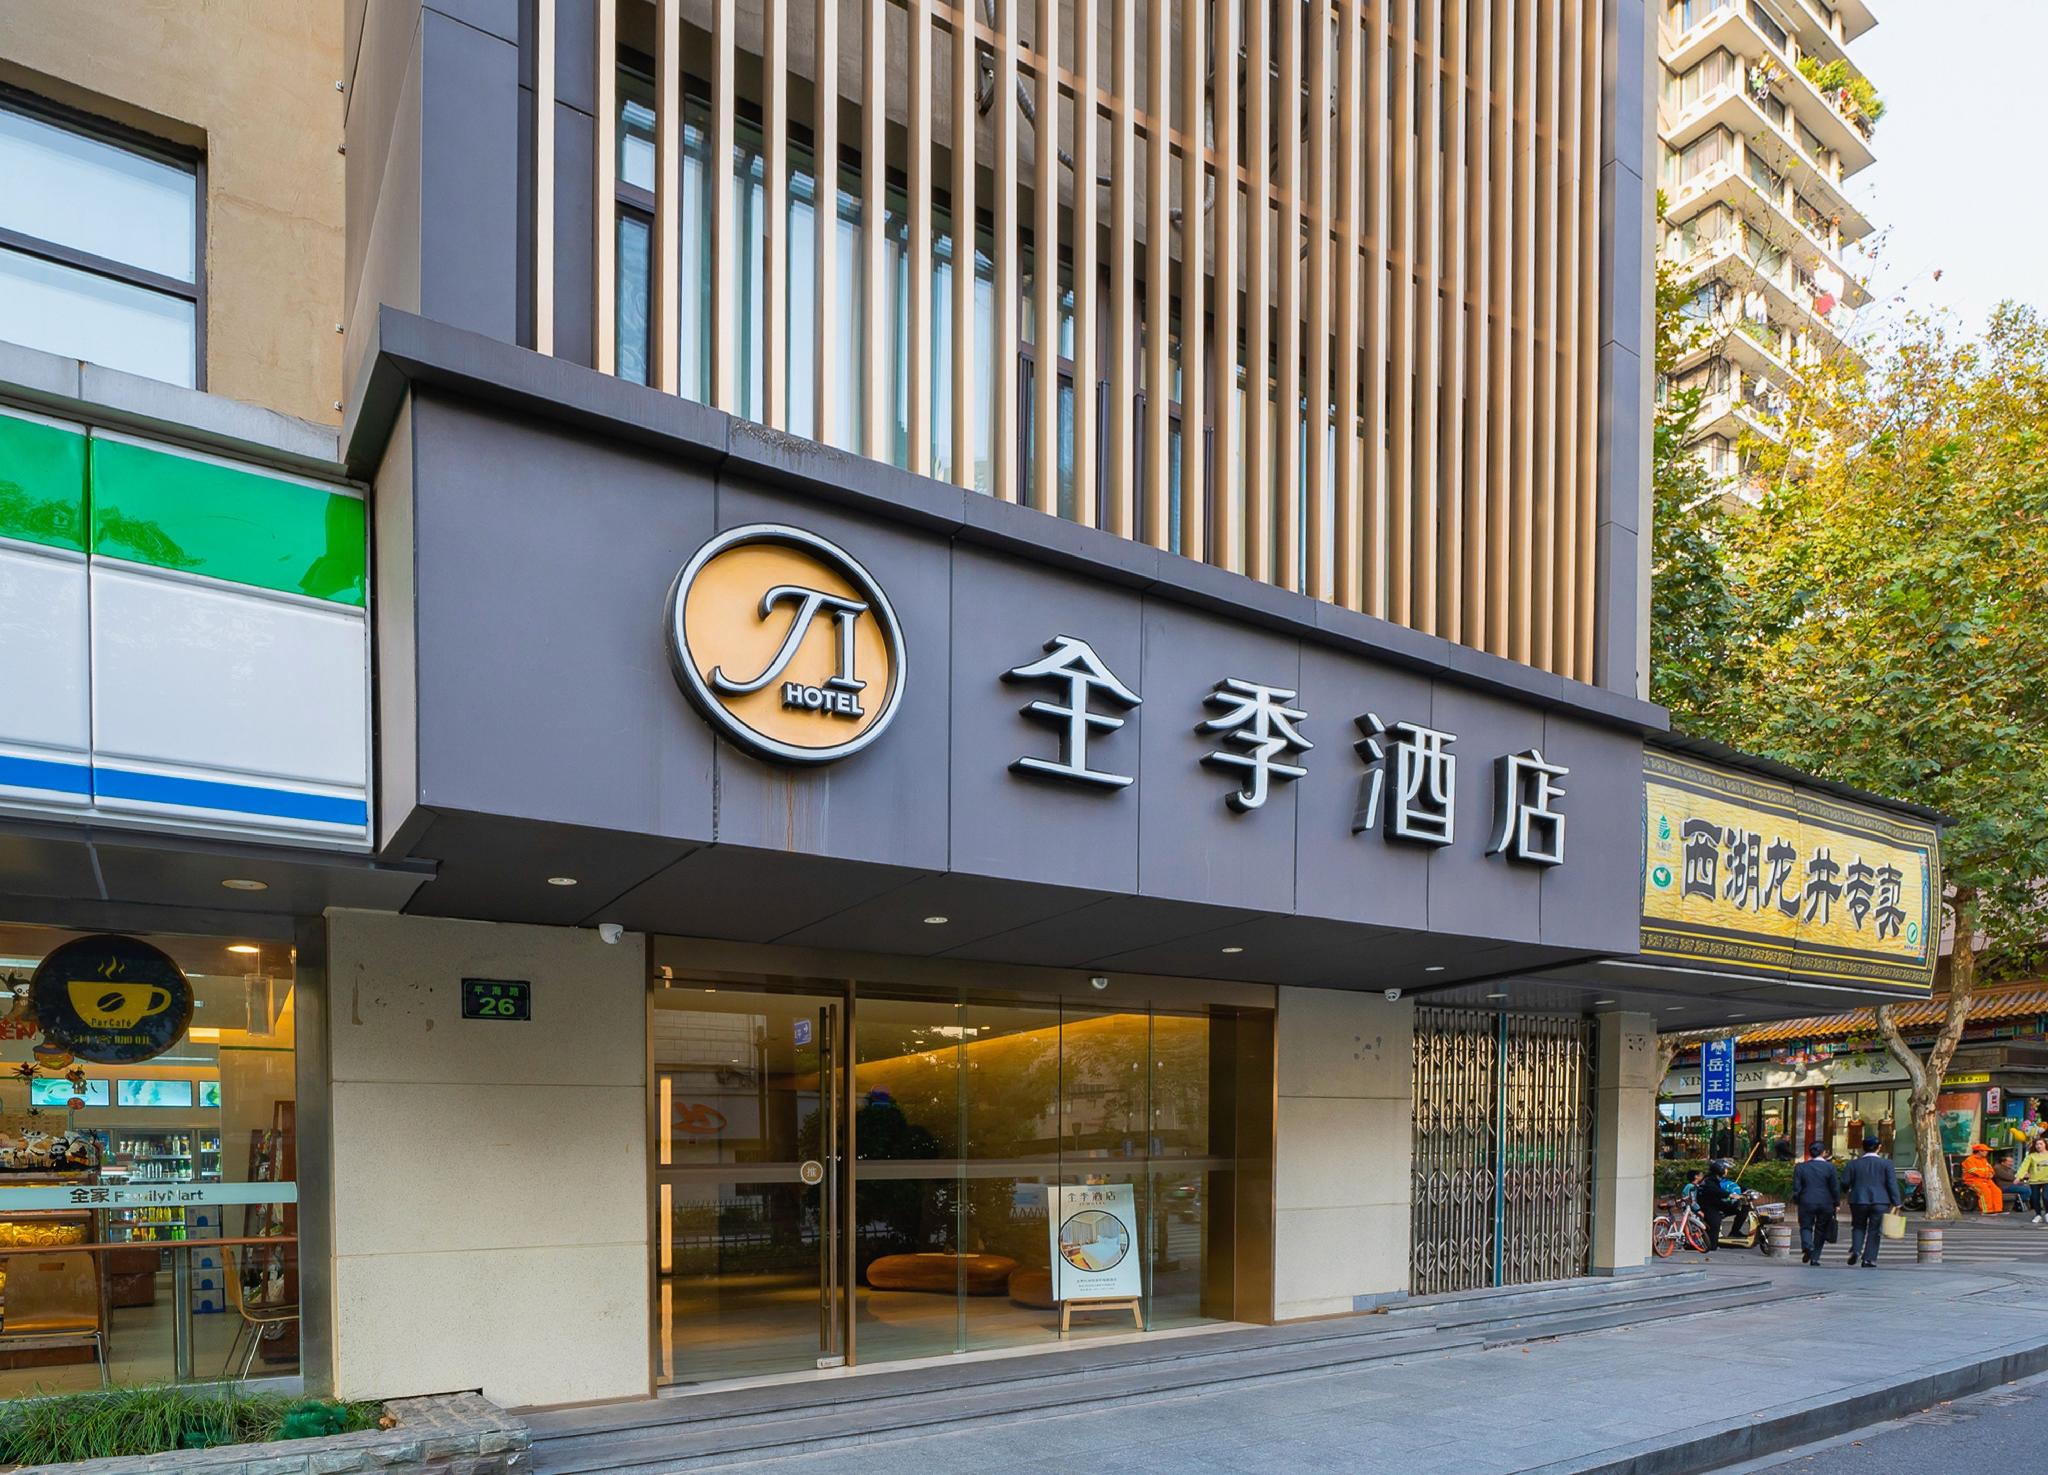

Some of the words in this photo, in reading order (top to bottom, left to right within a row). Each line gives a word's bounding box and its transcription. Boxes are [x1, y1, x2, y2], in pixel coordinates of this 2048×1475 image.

[781, 682, 865, 720] HOTEL
[1000, 633, 1571, 867] 全季酒店
[479, 997, 516, 1016] 26
[1707, 1058, 1724, 1112] 岳王路
[70, 1188, 110, 1204] 全家
